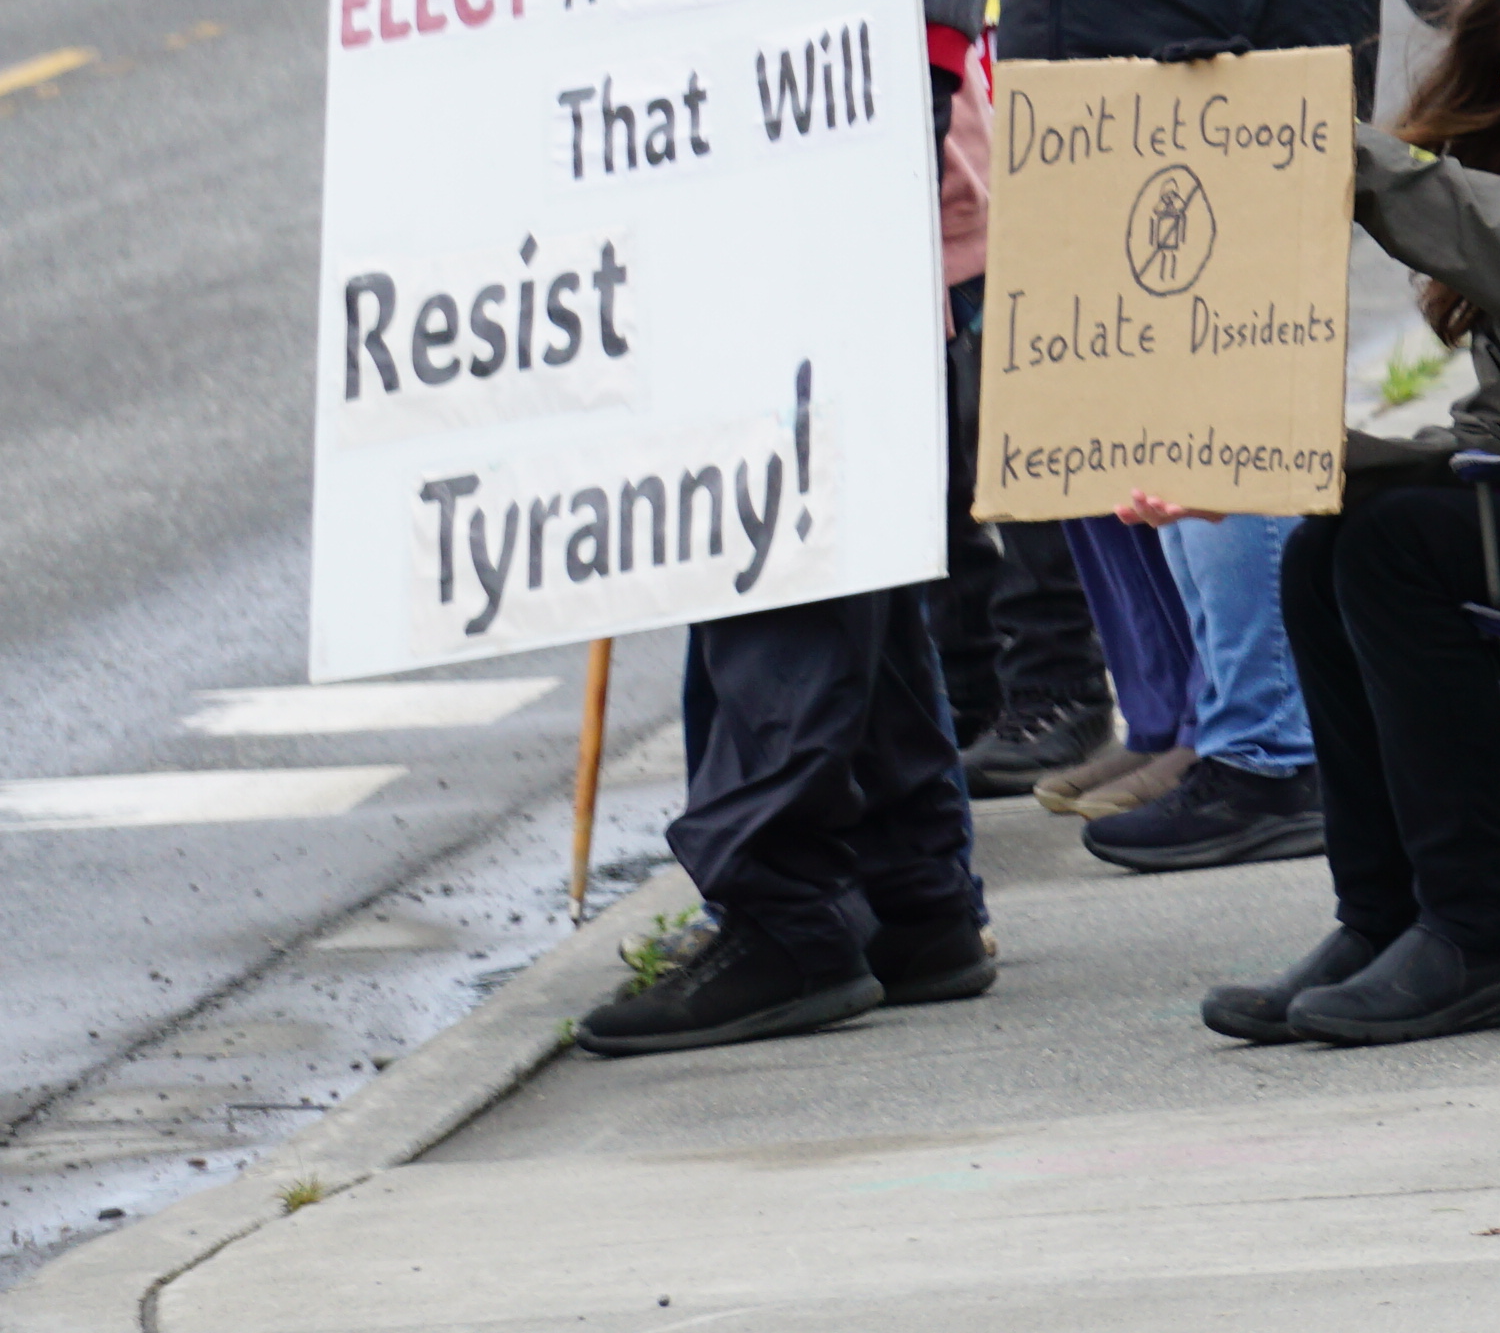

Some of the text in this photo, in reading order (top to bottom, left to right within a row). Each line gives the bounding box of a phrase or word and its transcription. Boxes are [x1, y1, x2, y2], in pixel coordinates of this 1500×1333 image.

[557, 19, 878, 181] That Will
[1008, 88, 1114, 175] Don't
[1200, 93, 1329, 170] Google
[343, 232, 629, 403] Resist
[1002, 289, 1337, 374] Isolate Dissidents
[418, 358, 815, 637] Tyranny!
[999, 426, 1336, 497] keepandroidopen.org
